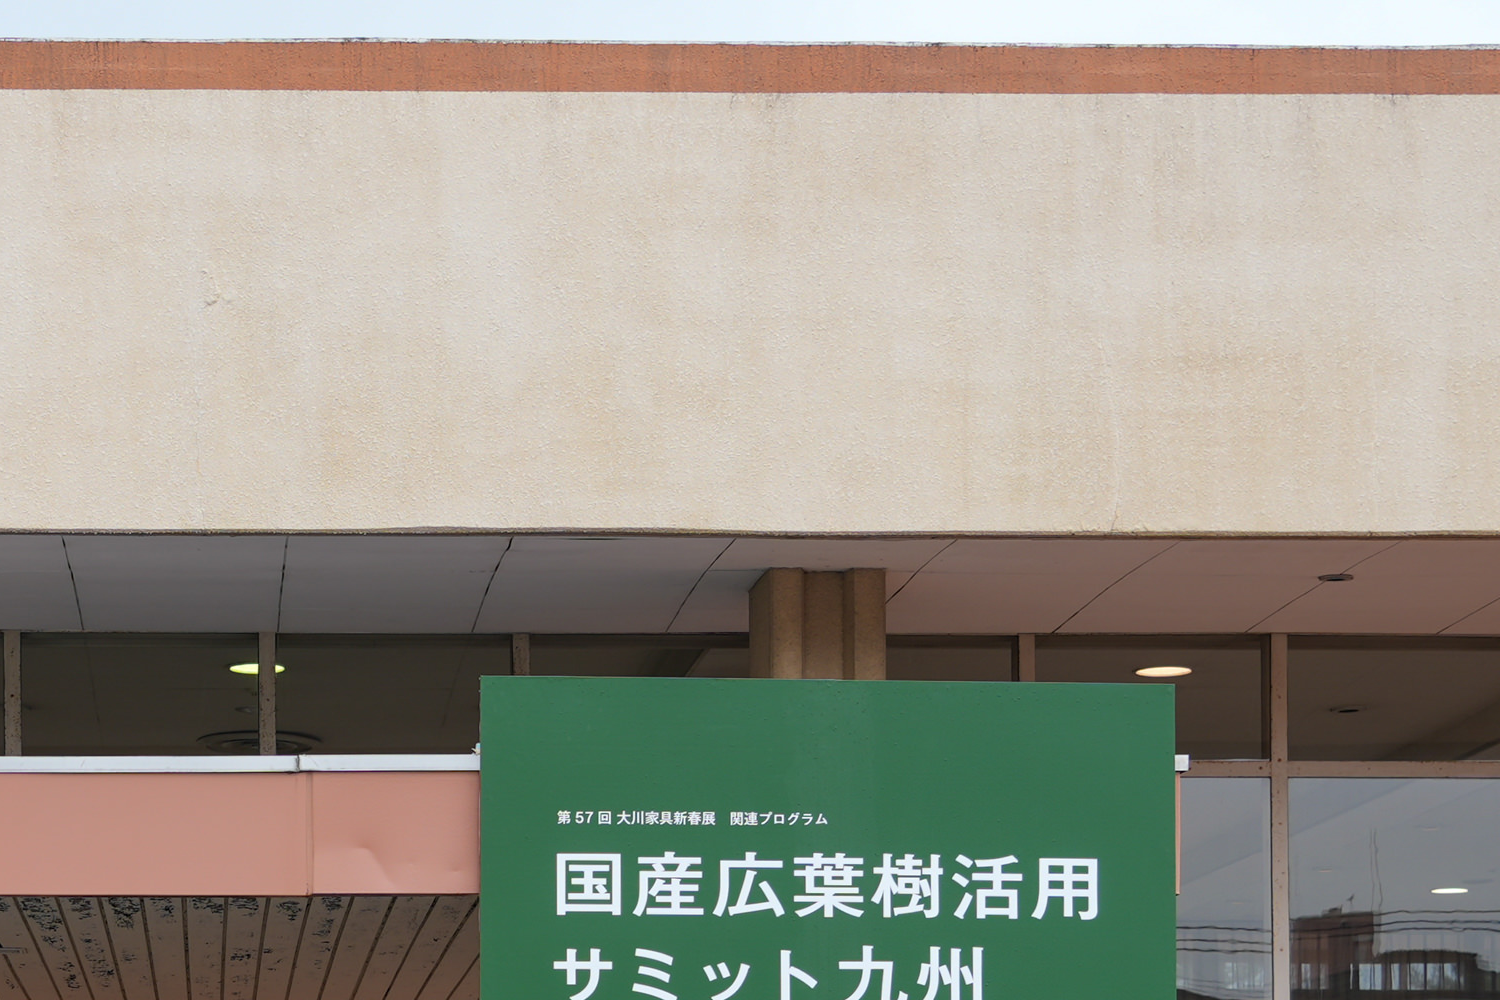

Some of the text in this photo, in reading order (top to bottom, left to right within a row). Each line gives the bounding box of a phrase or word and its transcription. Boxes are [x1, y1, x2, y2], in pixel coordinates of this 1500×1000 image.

[729, 811, 828, 826] 関連プログラム
[555, 850, 1100, 921] 国産広葉樹活用
